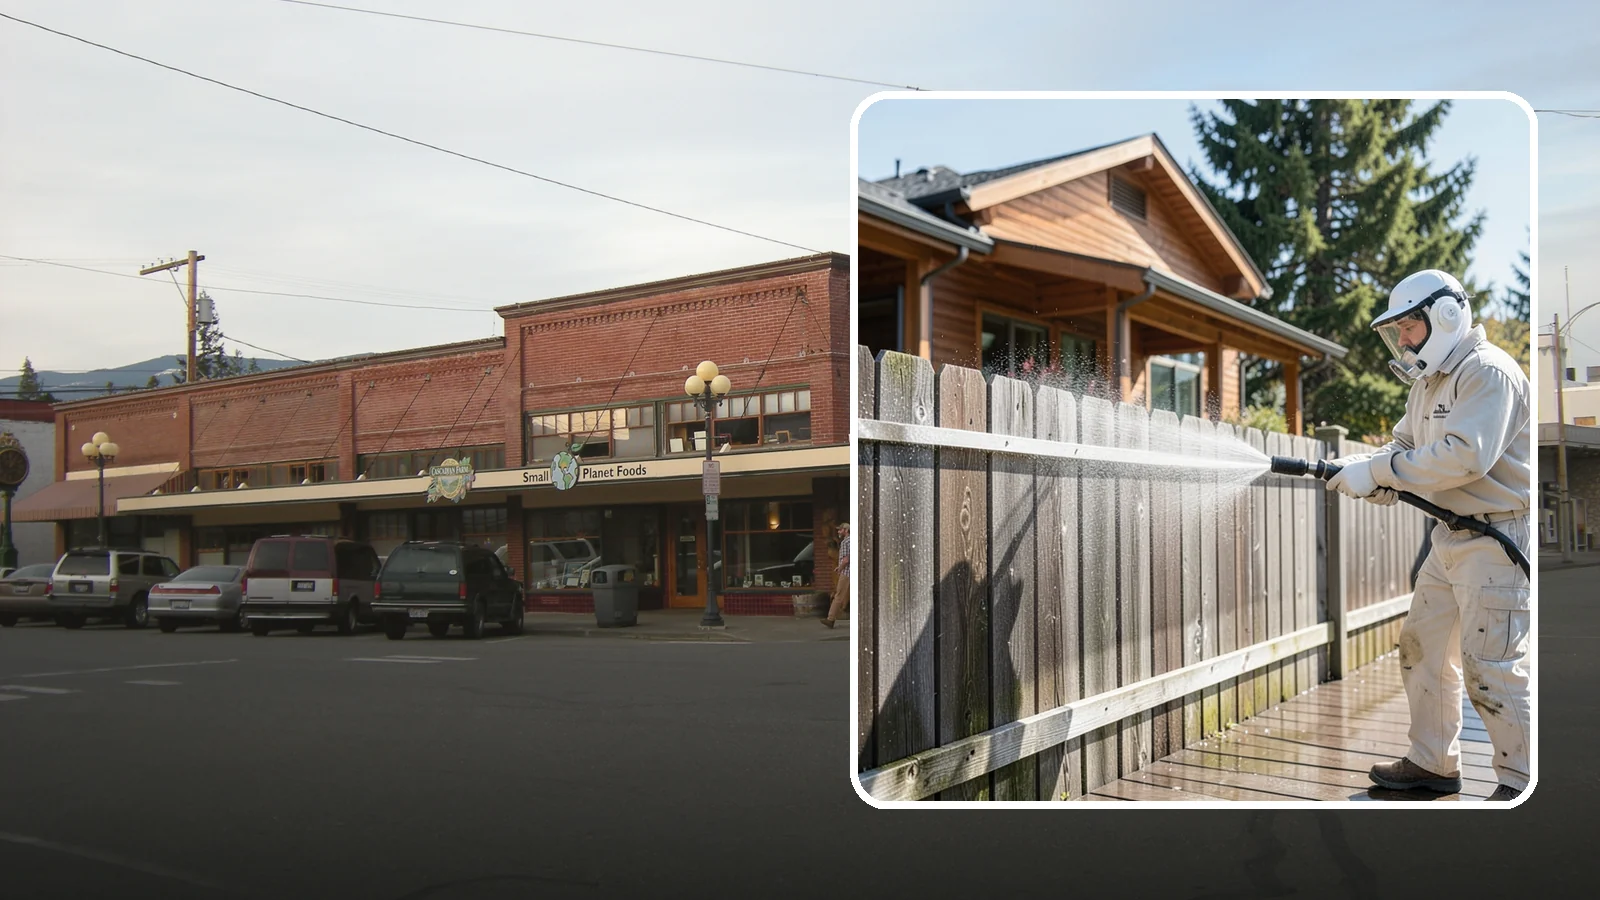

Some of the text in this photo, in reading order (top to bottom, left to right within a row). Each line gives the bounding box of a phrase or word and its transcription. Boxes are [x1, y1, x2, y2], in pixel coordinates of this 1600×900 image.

[523, 464, 647, 483] Small Planet Foods
